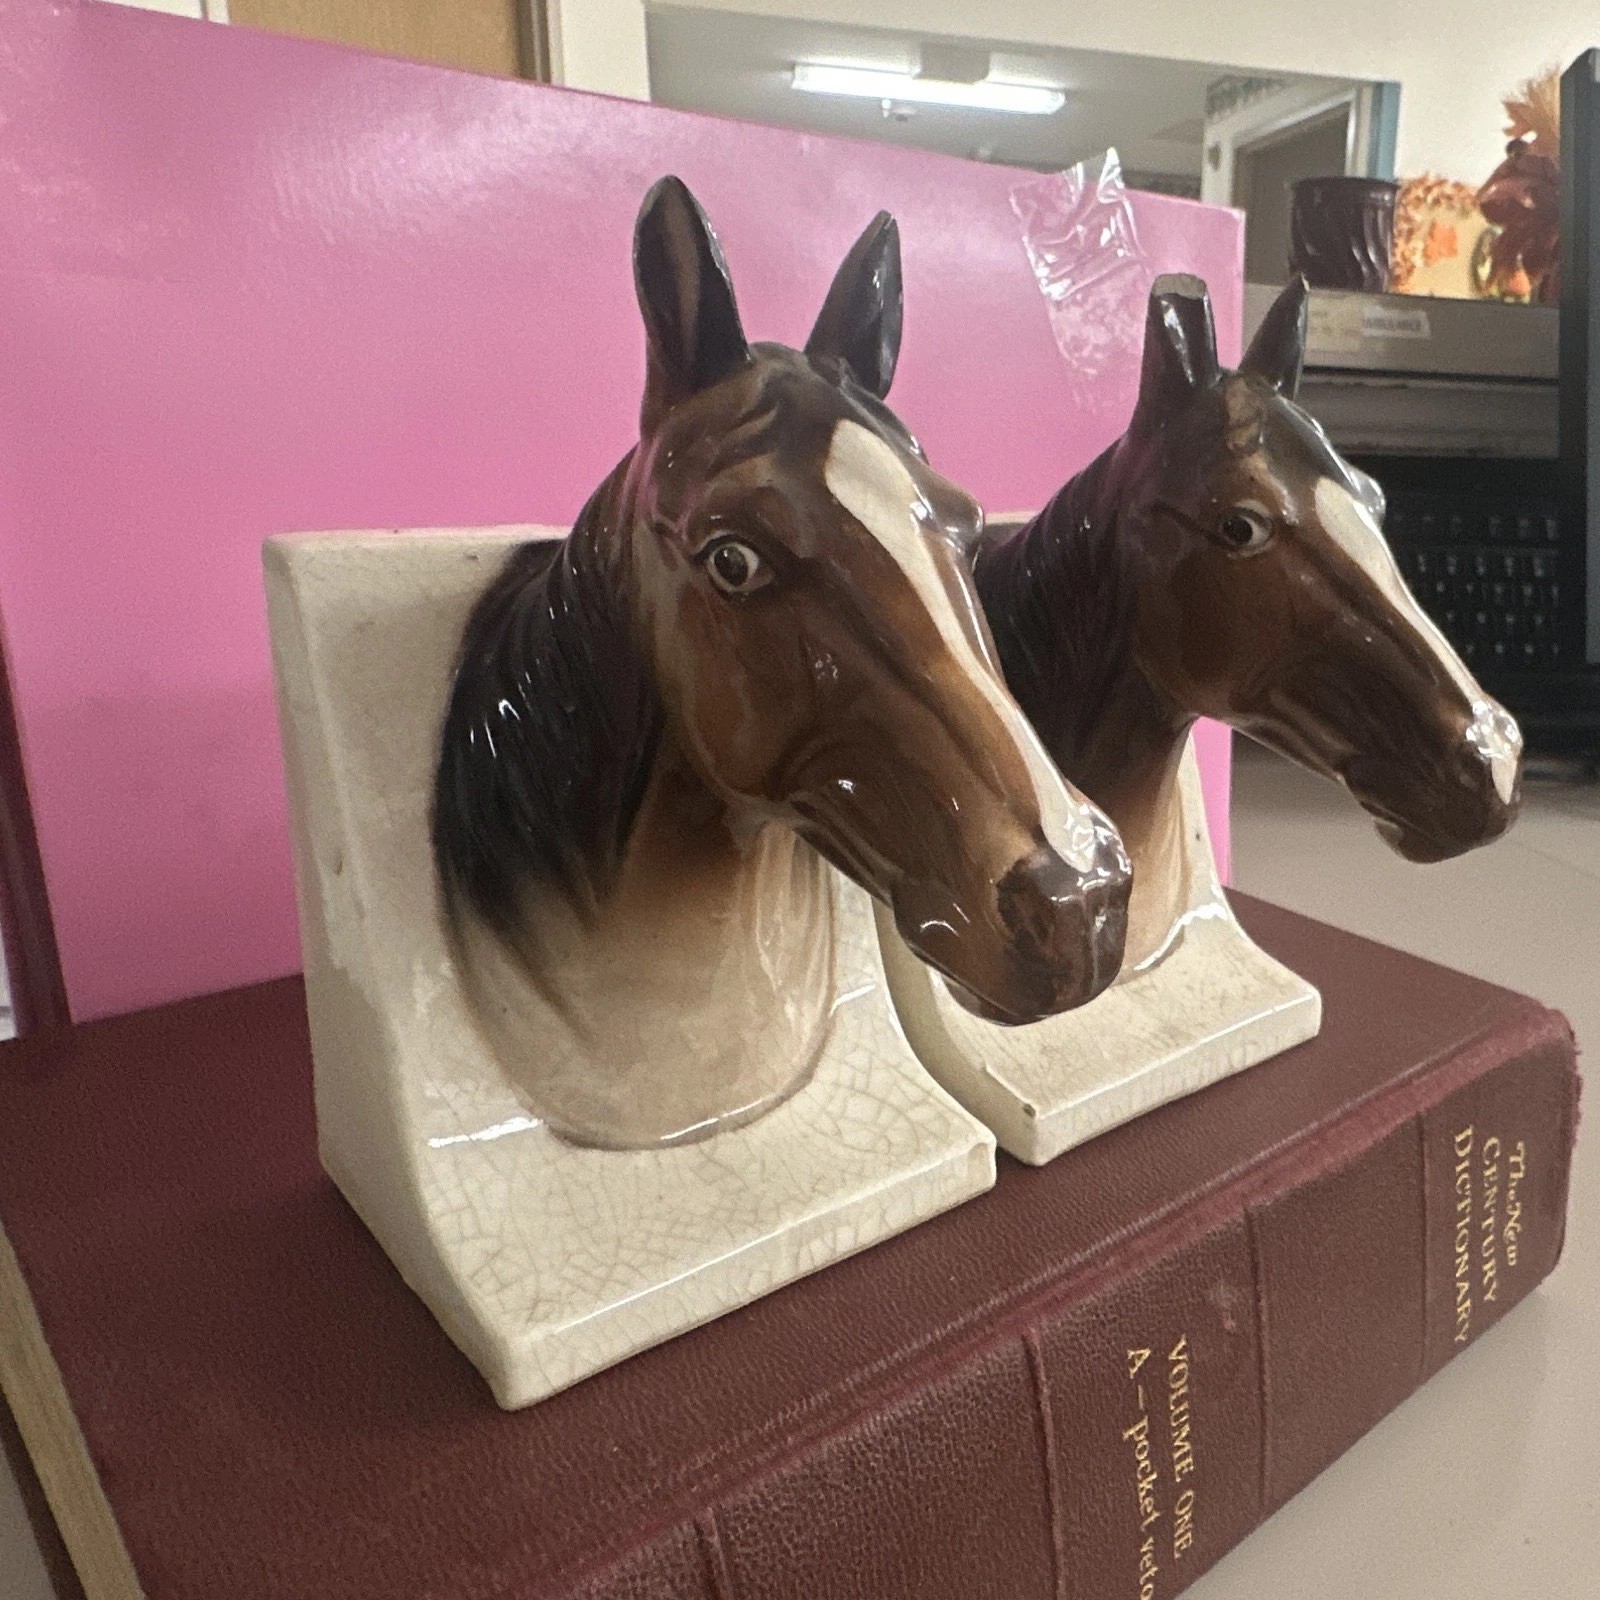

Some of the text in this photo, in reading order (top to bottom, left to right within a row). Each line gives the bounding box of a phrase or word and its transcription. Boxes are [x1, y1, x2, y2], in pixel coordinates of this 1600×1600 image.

[1454, 1125, 1473, 1342] DICTIONARY
[1482, 1136, 1500, 1302] CENTURY
[1503, 1141, 1525, 1266] The New
[1127, 1347, 1151, 1379] A
[1122, 1414, 1161, 1532] pocket
[1168, 1333, 1194, 1559] VOLUME ONE
[1139, 1536, 1159, 1600] veto
